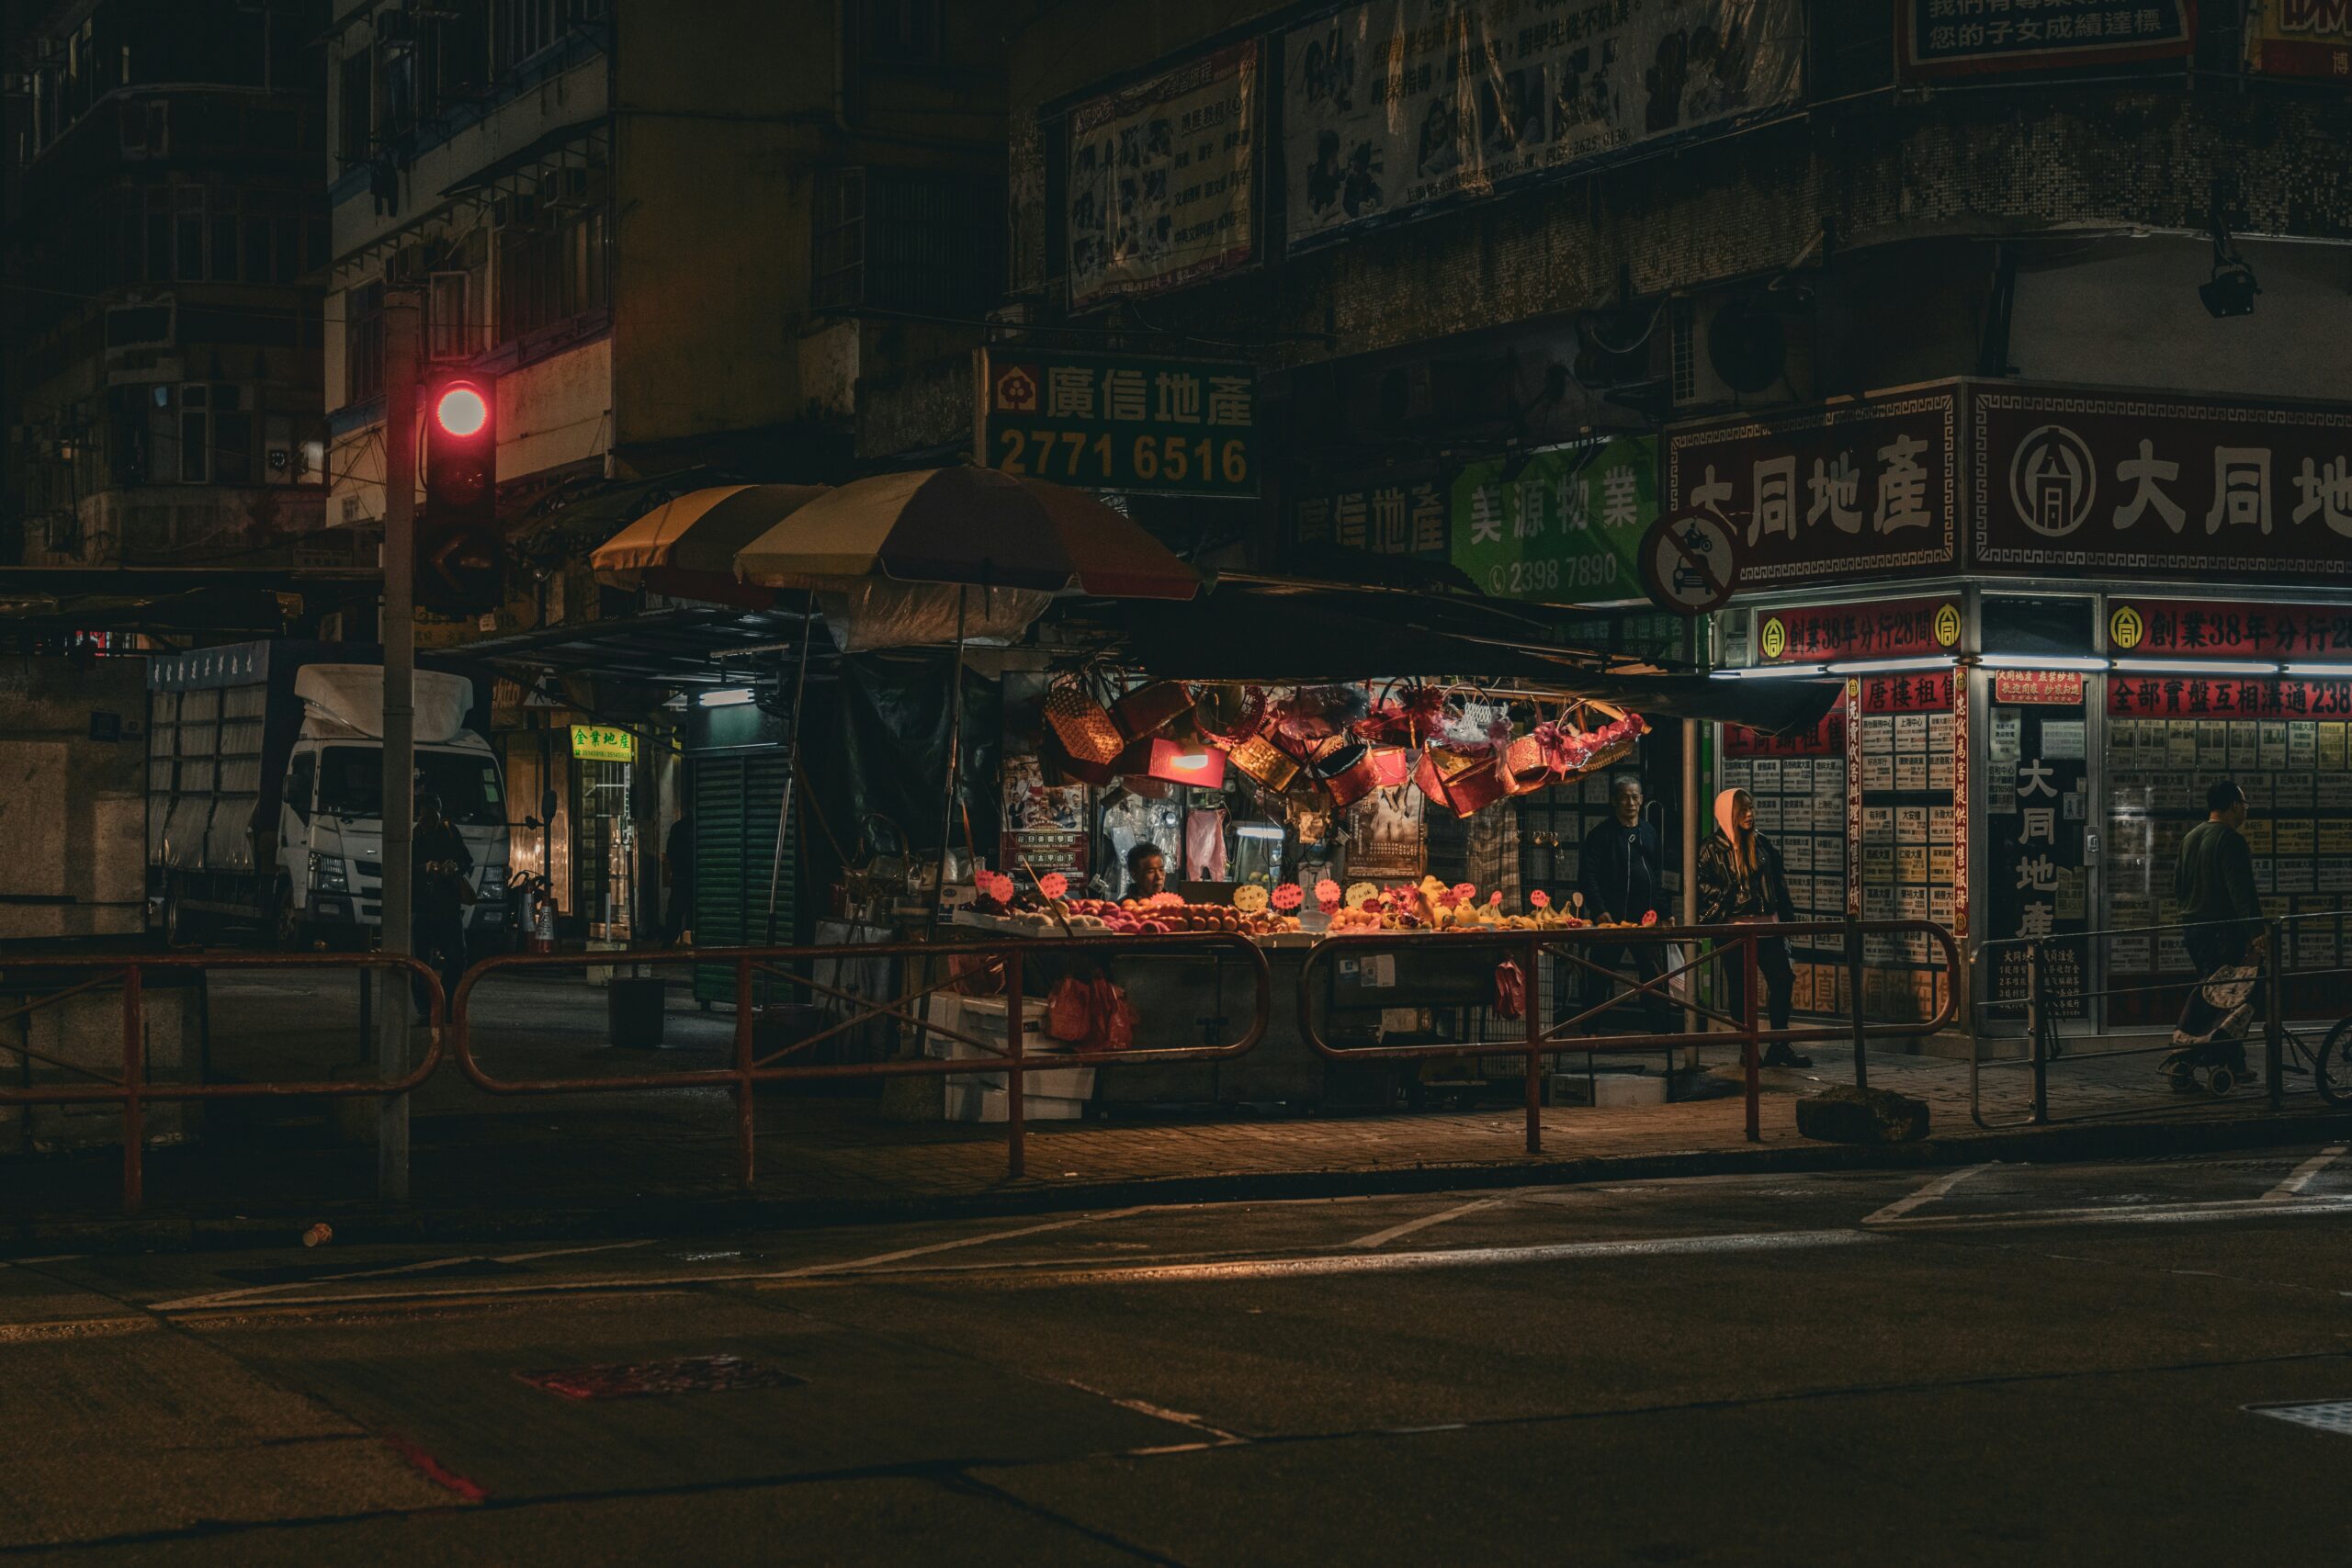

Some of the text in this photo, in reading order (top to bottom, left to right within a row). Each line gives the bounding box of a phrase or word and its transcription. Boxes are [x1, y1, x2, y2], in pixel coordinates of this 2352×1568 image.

[1928, 7, 2162, 50] 您的子女成績達標
[1046, 366, 1251, 426] 廣信地產
[1001, 429, 1247, 483] 2771 6516
[1470, 464, 1638, 546] 美源物業
[1690, 434, 1932, 548] 大同地產
[2112, 438, 2352, 538] 大同地
[1297, 481, 1445, 555] 廣信地產
[1509, 552, 1617, 593] 2398 7890
[1790, 608, 1932, 654] 創業38年分行28間
[1867, 674, 1954, 710] 唐樓租售
[2112, 678, 2352, 715] 全部實盤互相溝通238
[573, 728, 630, 749] 金業地產
[2015, 759, 2059, 941] 大同地產
